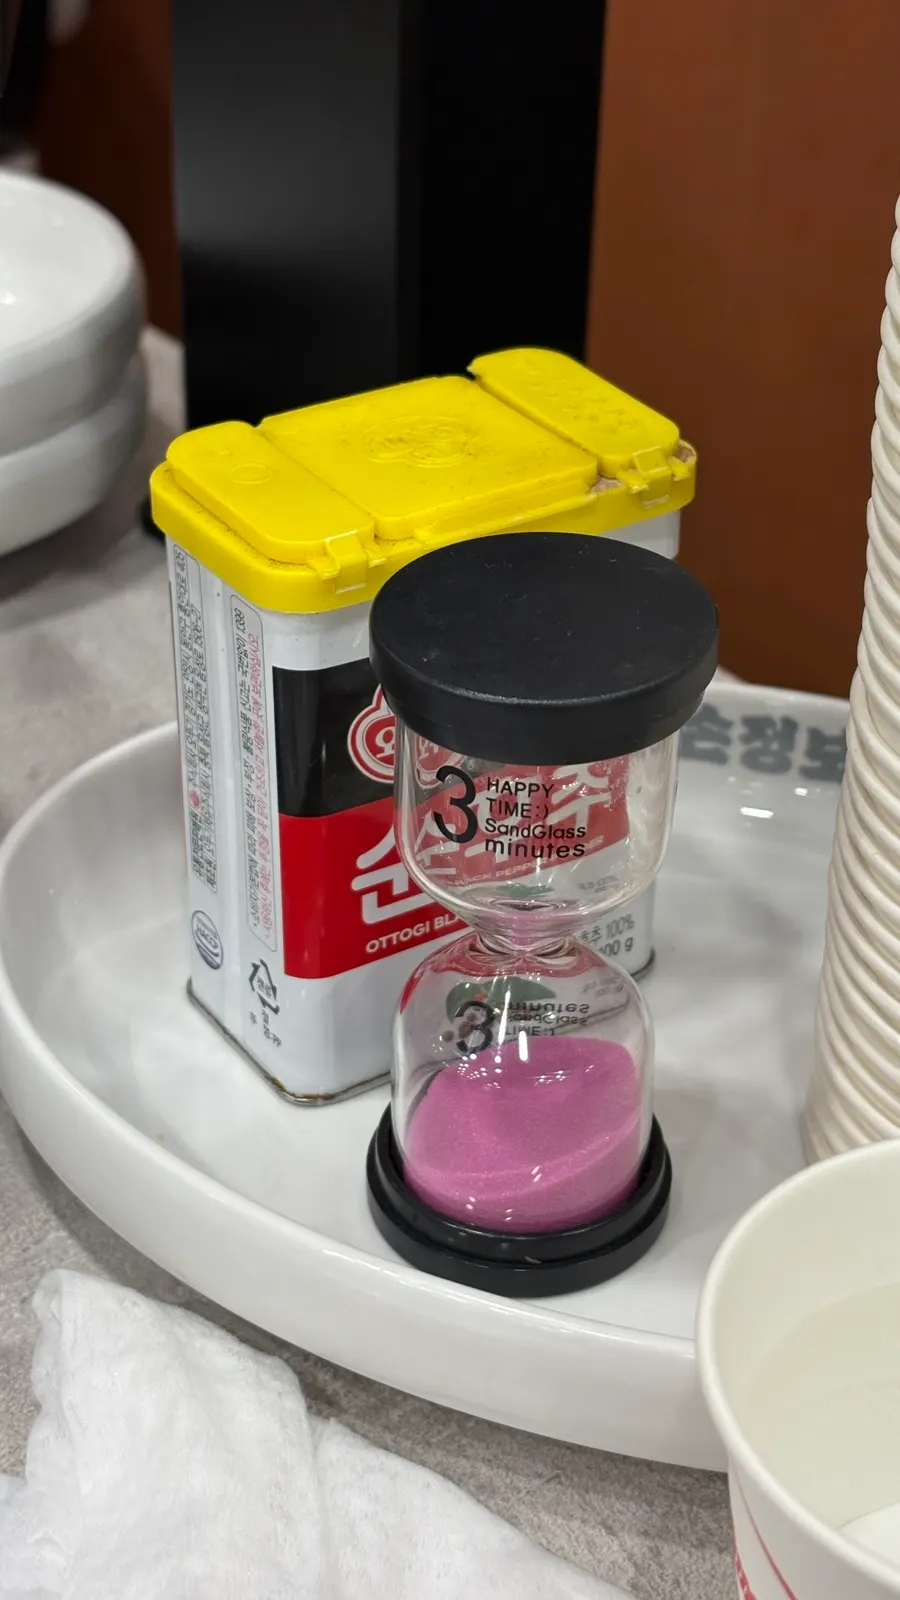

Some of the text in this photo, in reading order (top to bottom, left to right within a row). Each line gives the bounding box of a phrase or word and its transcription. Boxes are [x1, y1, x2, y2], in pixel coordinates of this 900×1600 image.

[234, 603, 245, 637] 1399
[235, 629, 250, 683] 국번없이
[238, 673, 251, 715] 신고는
[250, 691, 263, 725] 곳에
[252, 717, 264, 756] 서늘한
[244, 784, 256, 815] 보상
[487, 777, 555, 799] HAPPY
[434, 765, 478, 844] 3
[246, 830, 257, 858] 따라
[485, 818, 587, 840] SandGlass
[485, 838, 586, 859] minutes
[366, 922, 430, 953] OTTOGI
[605, 913, 635, 939] 100%
[624, 936, 634, 952] g
